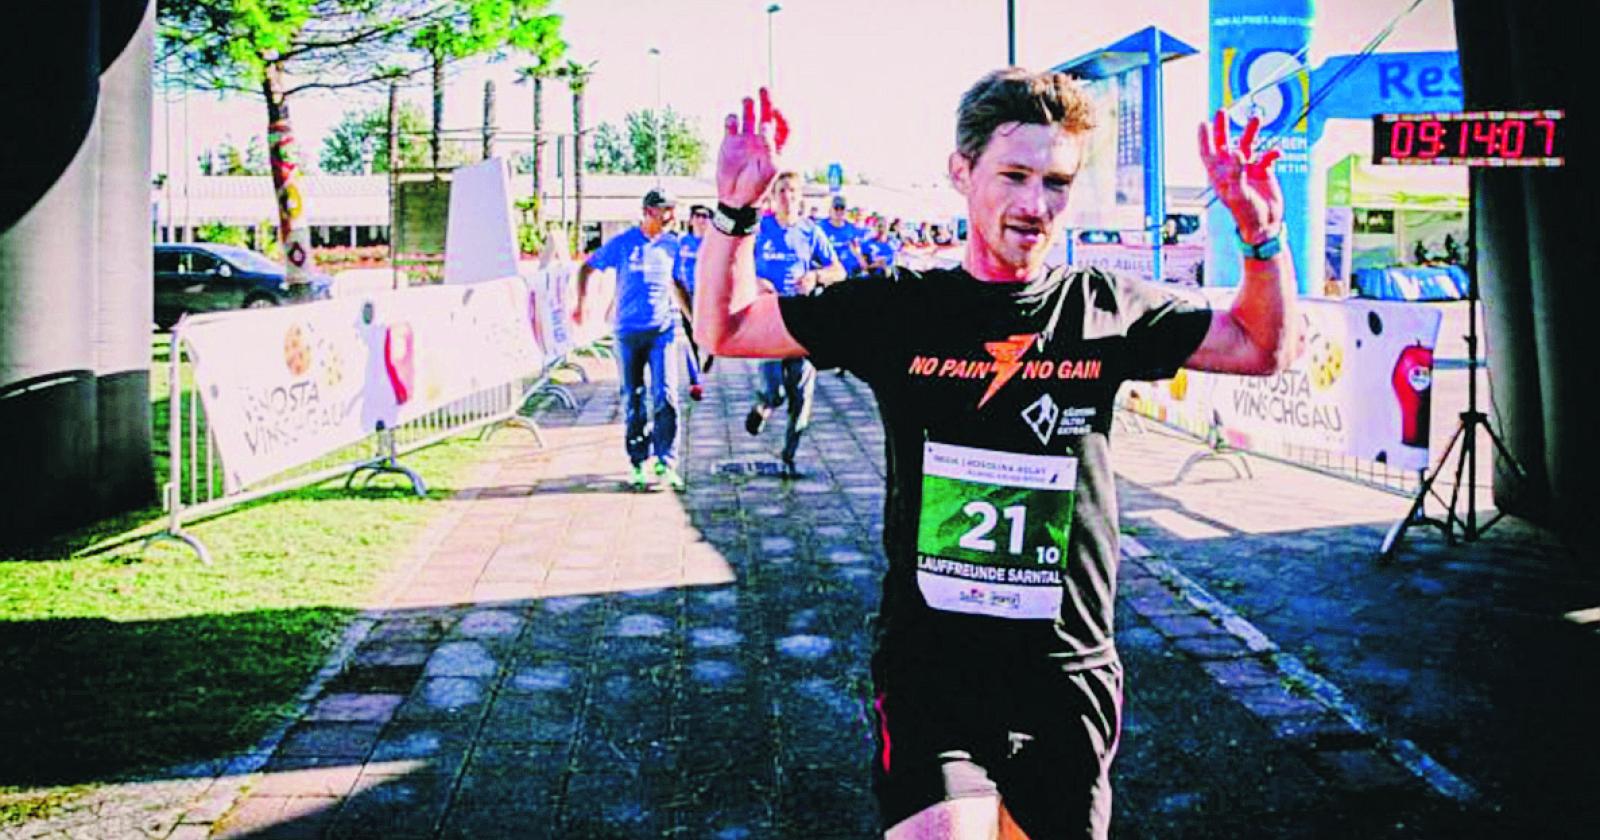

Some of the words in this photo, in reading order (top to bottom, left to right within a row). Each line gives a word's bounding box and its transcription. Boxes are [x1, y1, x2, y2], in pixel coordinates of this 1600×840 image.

[1390, 119, 1556, 159] 09:14:07
[909, 355, 938, 375] NO
[938, 358, 991, 379] PAIN
[1022, 360, 1053, 380] NO
[1057, 360, 1101, 379] GAIN
[1233, 388, 1342, 432] VINSCHGAU
[959, 500, 1027, 556] 21
[917, 555, 1005, 581] LAUFFREUNDE
[1008, 567, 1062, 584] SARNTAL
[1036, 546, 1061, 565] 10
